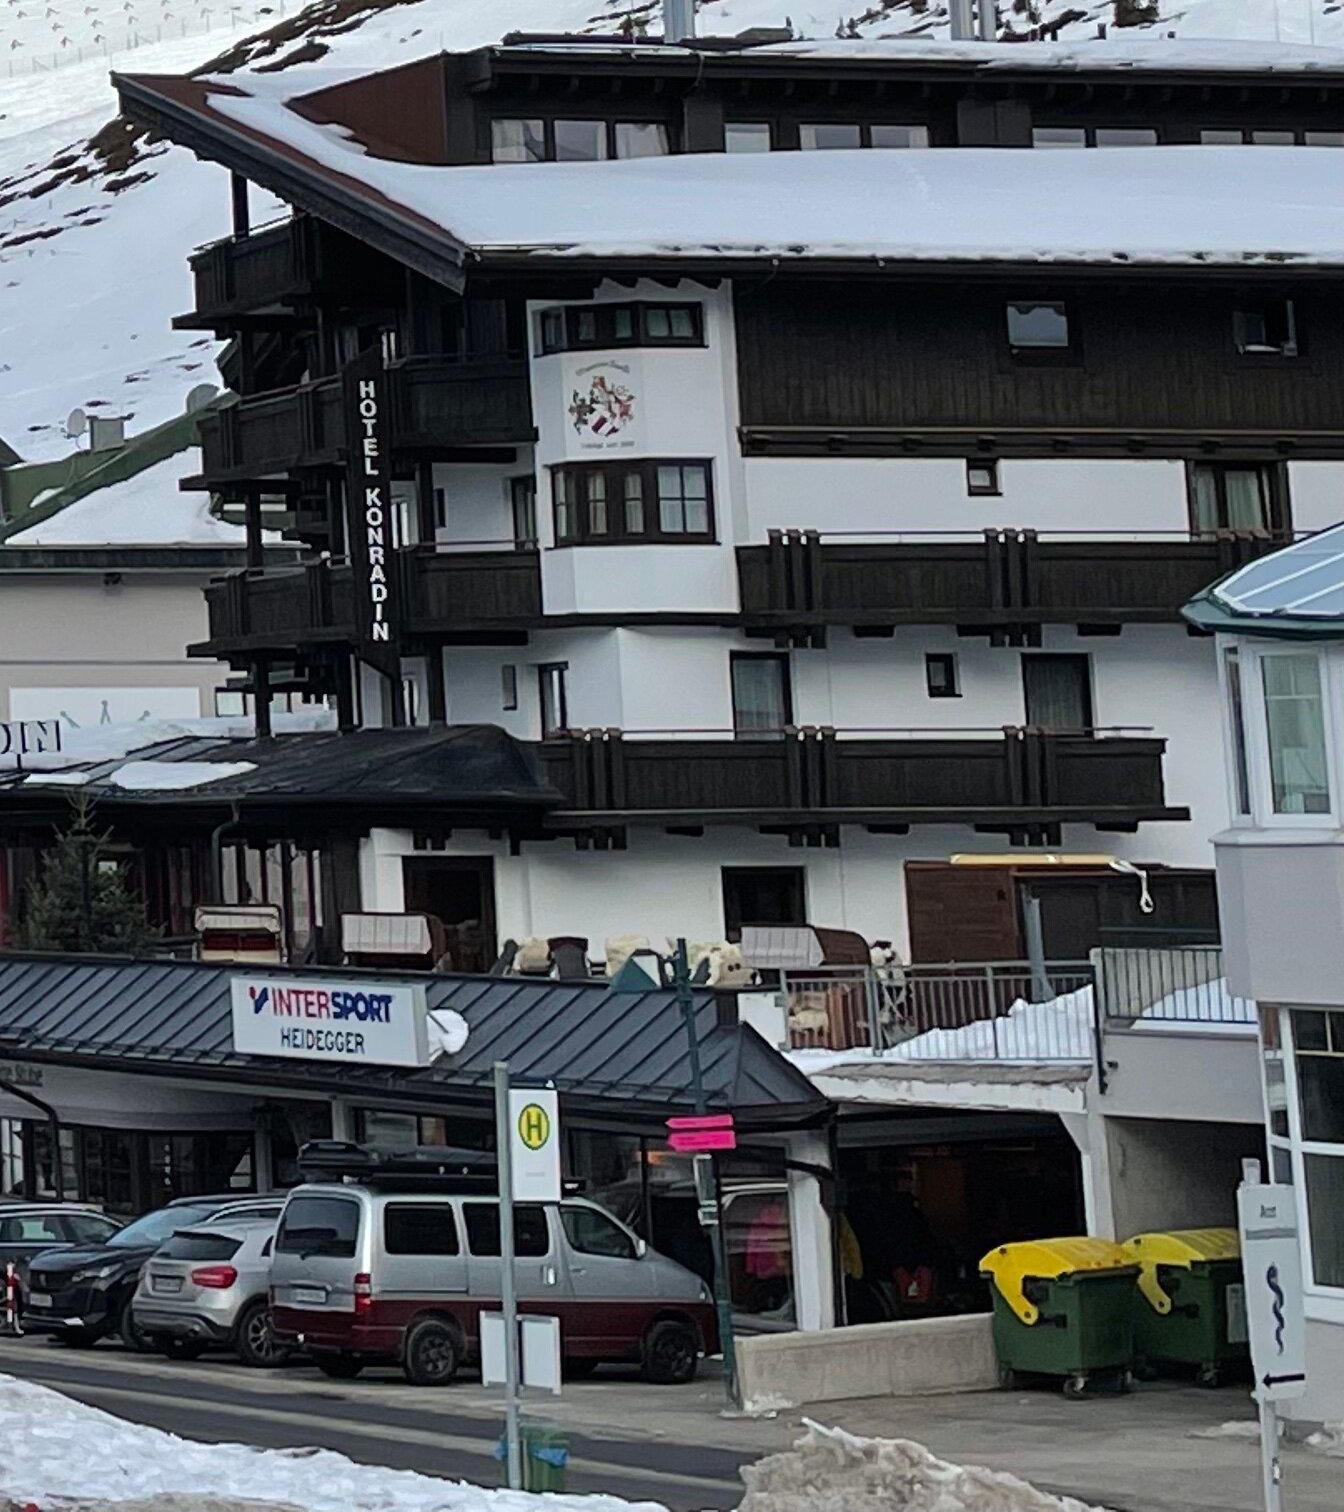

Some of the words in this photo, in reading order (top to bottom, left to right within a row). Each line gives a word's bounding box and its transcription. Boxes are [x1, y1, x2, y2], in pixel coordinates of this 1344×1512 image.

[359, 380, 379, 476] HOTEL
[365, 488, 389, 642] KONRADIN
[271, 987, 393, 1023] INTERSPORT
[280, 1025, 366, 1054] HEIDEGGER
